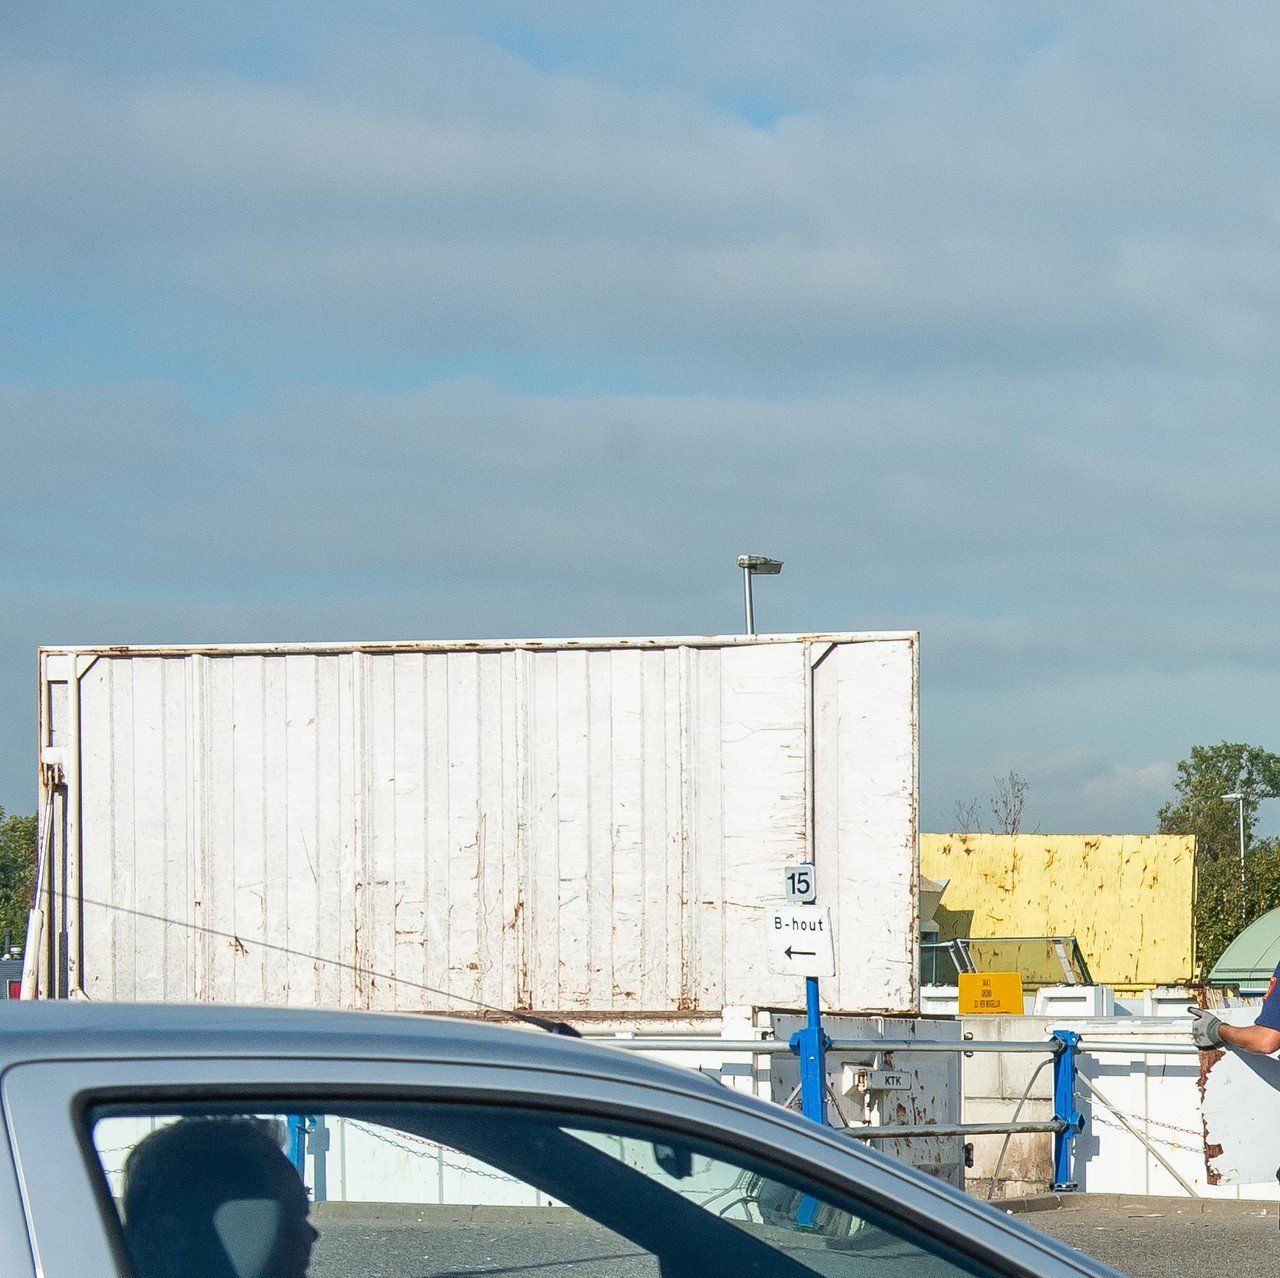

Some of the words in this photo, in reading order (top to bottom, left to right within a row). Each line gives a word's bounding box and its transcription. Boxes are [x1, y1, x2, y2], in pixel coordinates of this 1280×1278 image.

[787, 872, 810, 895] 15
[774, 917, 823, 931] B-hout
[884, 1075, 902, 1086] KTK
